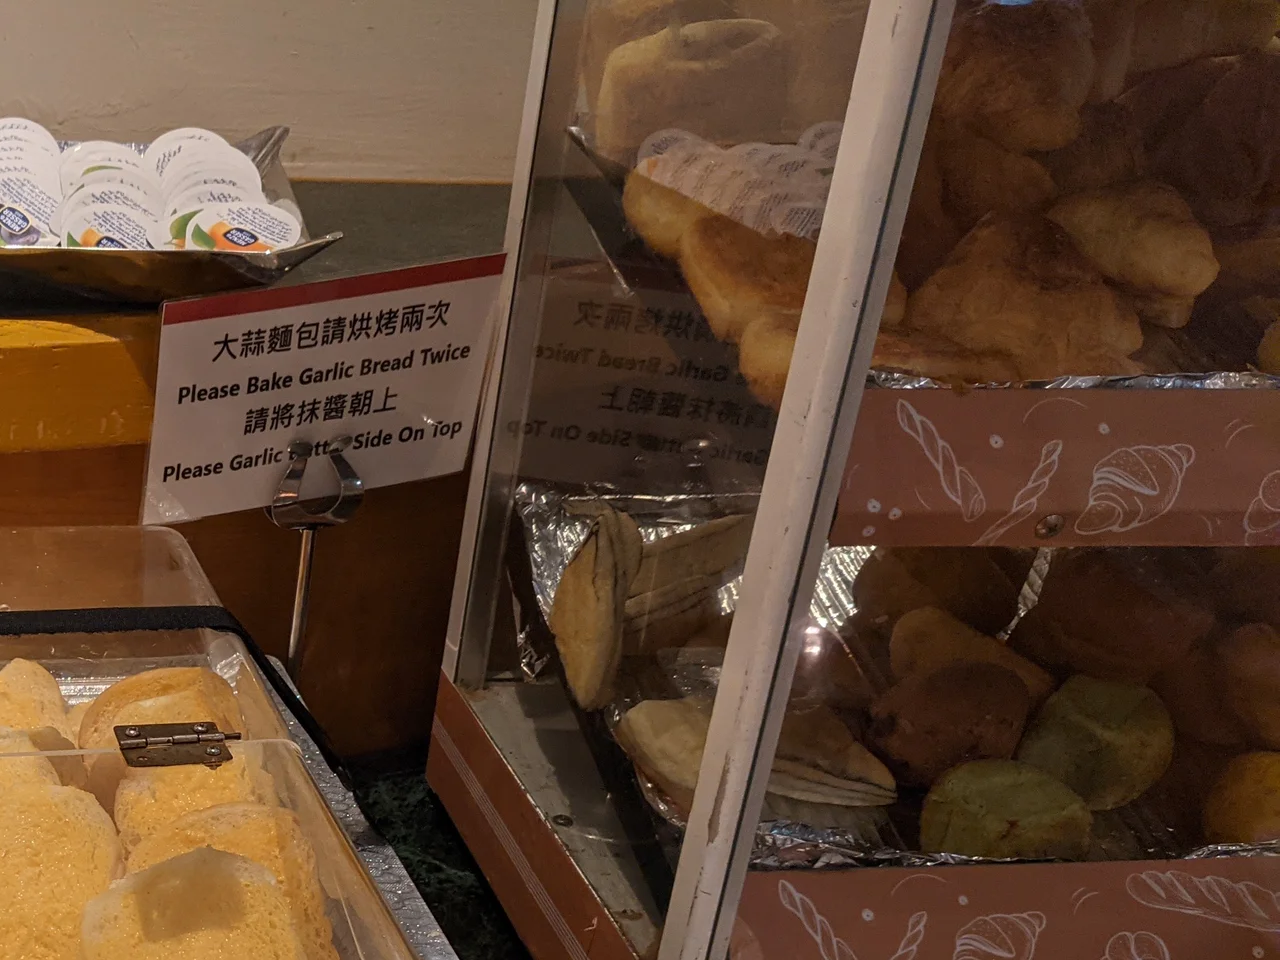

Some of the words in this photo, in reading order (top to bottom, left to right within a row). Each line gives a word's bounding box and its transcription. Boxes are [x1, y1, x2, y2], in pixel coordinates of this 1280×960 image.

[212, 300, 451, 363] 大蒜麵包請烘烤兩次
[177, 378, 240, 405] Please
[246, 371, 294, 395] Bake
[299, 360, 355, 385] Garlic
[359, 350, 415, 376] Bread
[419, 343, 471, 367] Twice
[243, 387, 398, 436] 請將抹醬朝上
[162, 456, 224, 483] Please
[229, 446, 284, 472] Garlic
[351, 429, 393, 451] Side
[397, 424, 426, 443] On
[429, 419, 464, 441] Top
